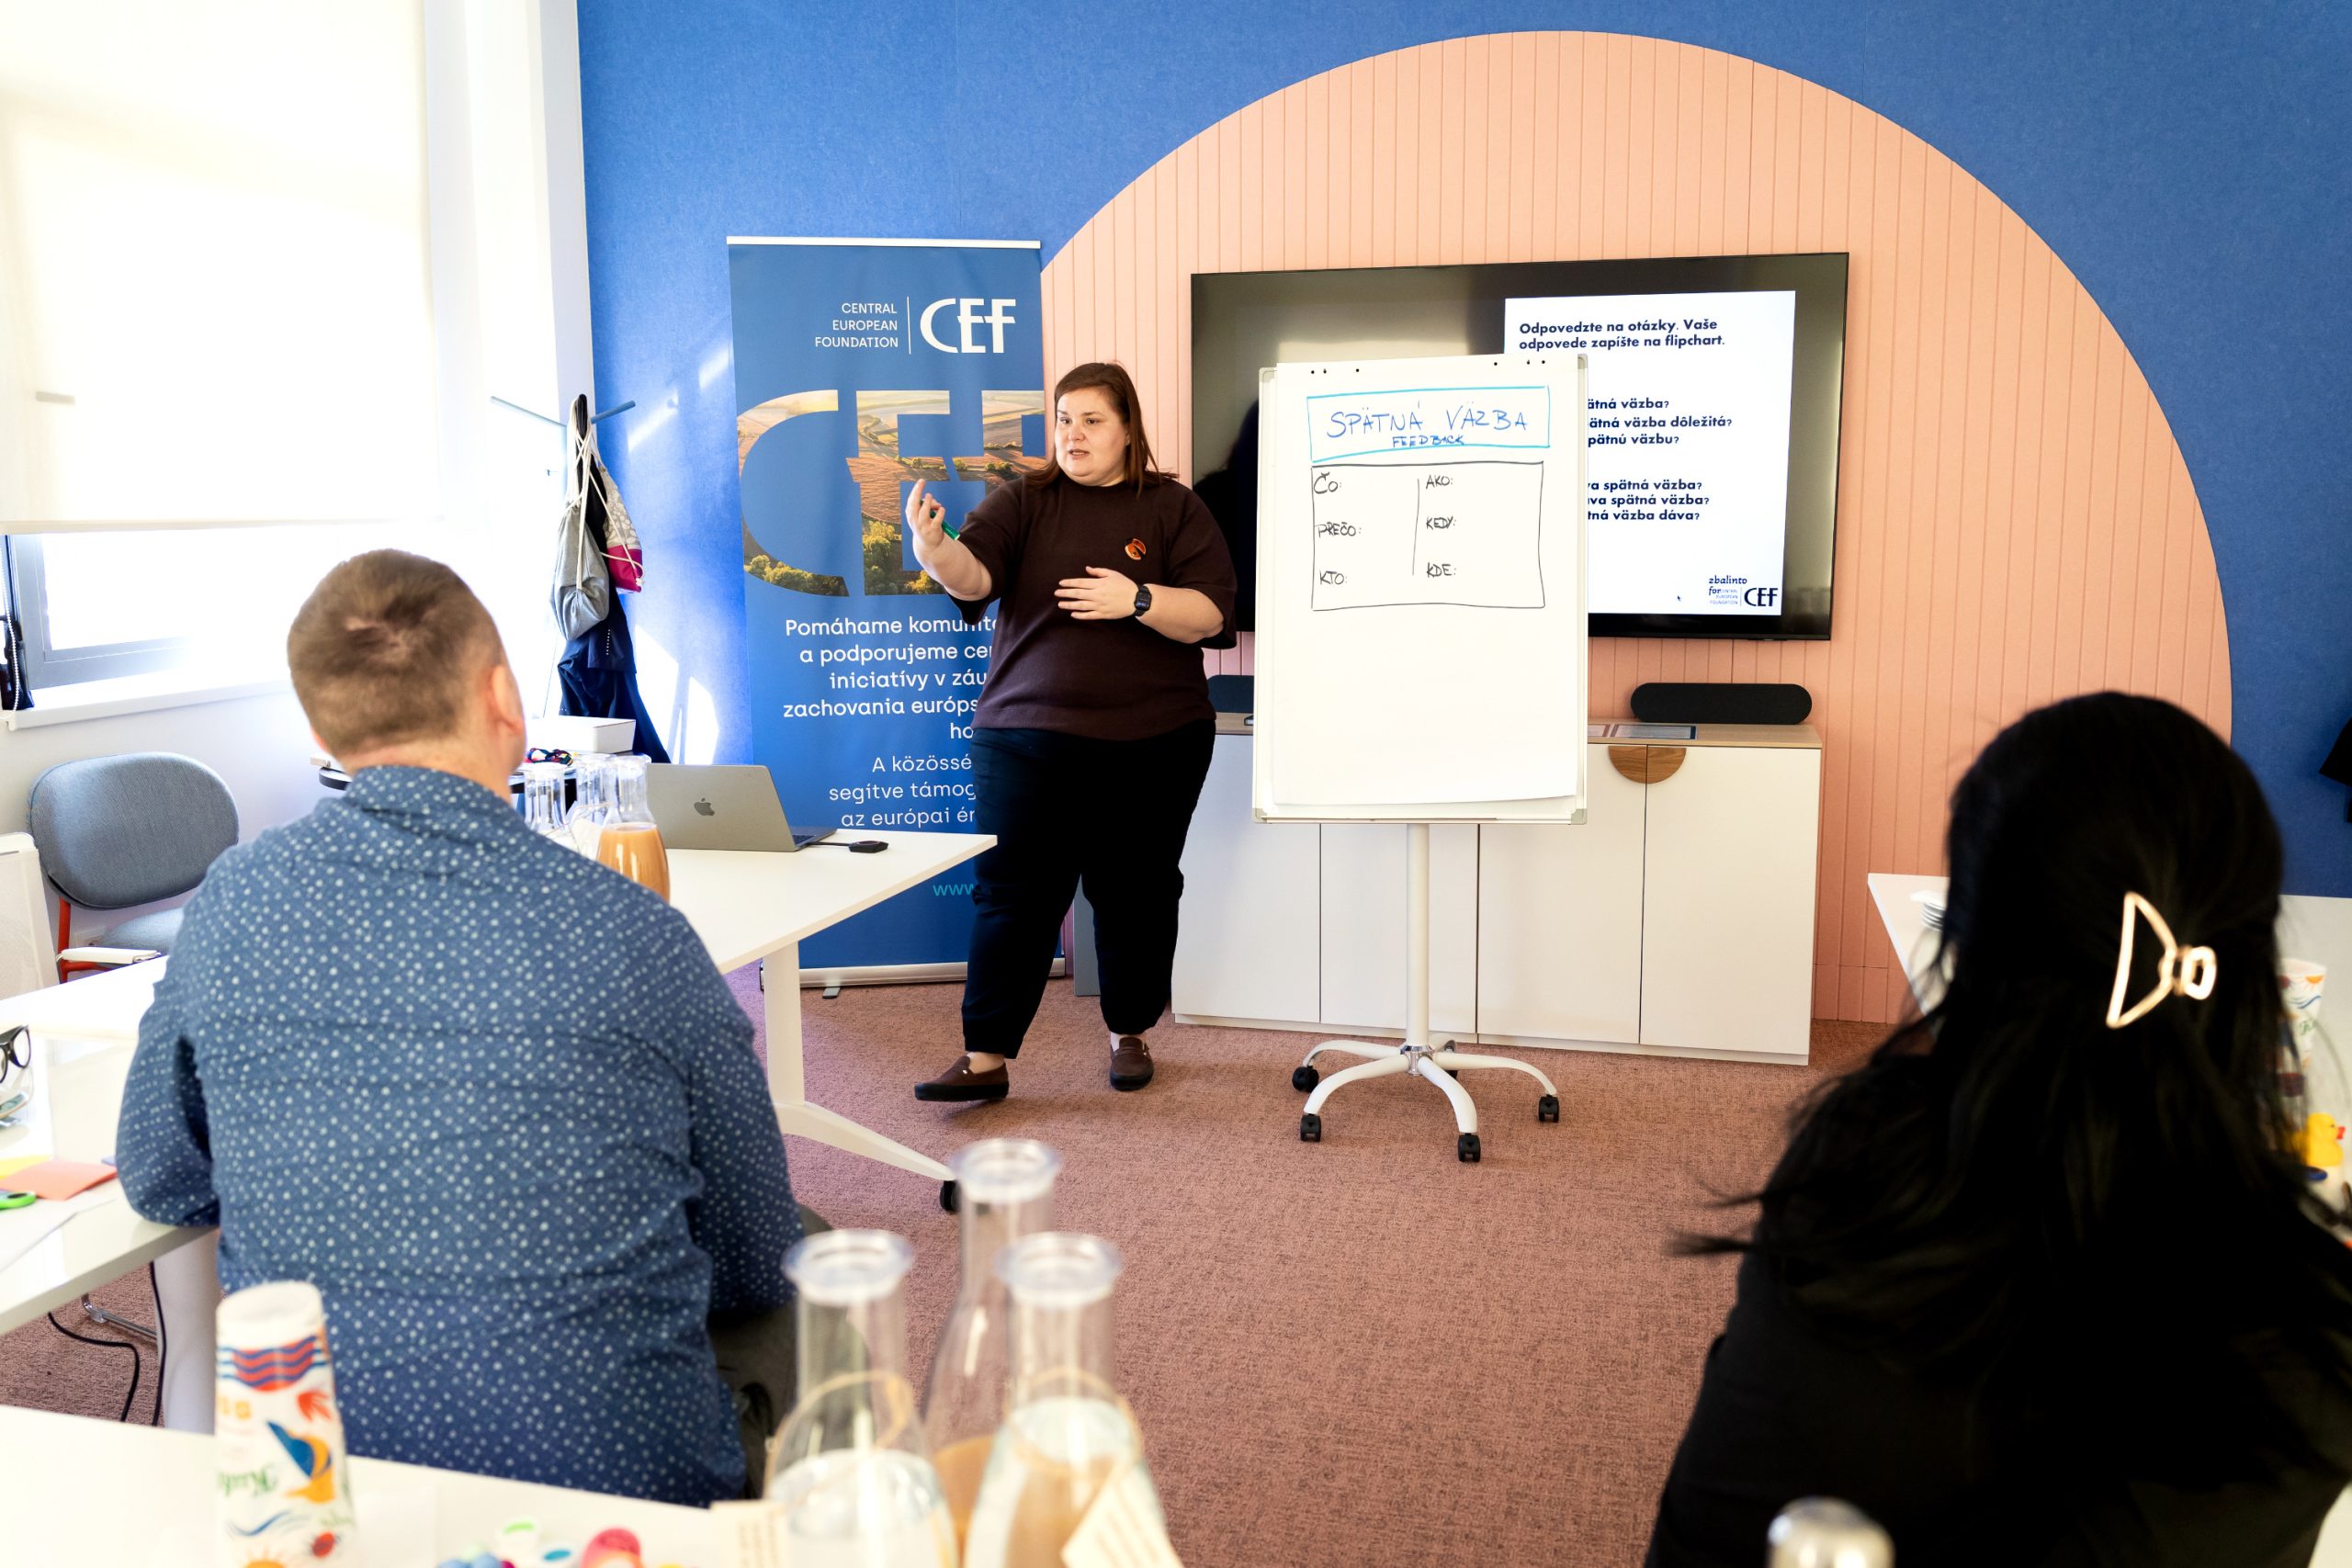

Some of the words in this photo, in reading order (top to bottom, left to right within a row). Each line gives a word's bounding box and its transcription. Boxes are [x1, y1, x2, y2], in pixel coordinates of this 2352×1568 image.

[842, 302, 898, 314] CENTRAL
[832, 320, 898, 332] EUROPEAN
[920, 298, 1016, 354] CEF
[1520, 321, 1602, 336] Odpovedzte
[1607, 322, 1623, 333] na
[1628, 319, 1679, 333] otázky.
[1683, 319, 1718, 330] Vaše
[815, 336, 899, 348] FOUNDATION
[1519, 337, 1588, 351] odpovede
[1591, 336, 1639, 350] zapíšte
[1644, 337, 1661, 346] na
[1665, 334, 1724, 348] flipchart.
[1621, 397, 1669, 409] väzba?
[1327, 400, 1422, 437] SPÄTNÁ
[1624, 416, 1667, 428] väzba
[1670, 415, 1732, 427] dôležitá?
[1393, 434, 1464, 447] FEEDBACK
[1631, 433, 1679, 445] väzbu?
[1426, 474, 1453, 490] AKO:
[1603, 479, 1649, 493] spätná
[1654, 478, 1702, 491] väzba?
[1588, 497, 1607, 505] va
[1611, 493, 1657, 508] spätná
[1661, 493, 1710, 505] väzba?
[1613, 509, 1655, 520] väzba
[1659, 509, 1700, 520] dáva?
[1426, 562, 1456, 578] KDE:
[1744, 588, 1778, 606] CEF
[786, 617, 902, 636] Pomáhame
[799, 649, 813, 663] a
[820, 644, 957, 666] podporujeme
[830, 670, 928, 691] iniciatívy
[934, 672, 946, 686] v
[783, 698, 905, 717] zachovania
[910, 696, 978, 716] európs
[873, 757, 885, 773] A
[892, 753, 972, 772] közössé
[829, 783, 903, 804] segítve
[842, 814, 865, 826] az
[872, 807, 949, 828] európai
